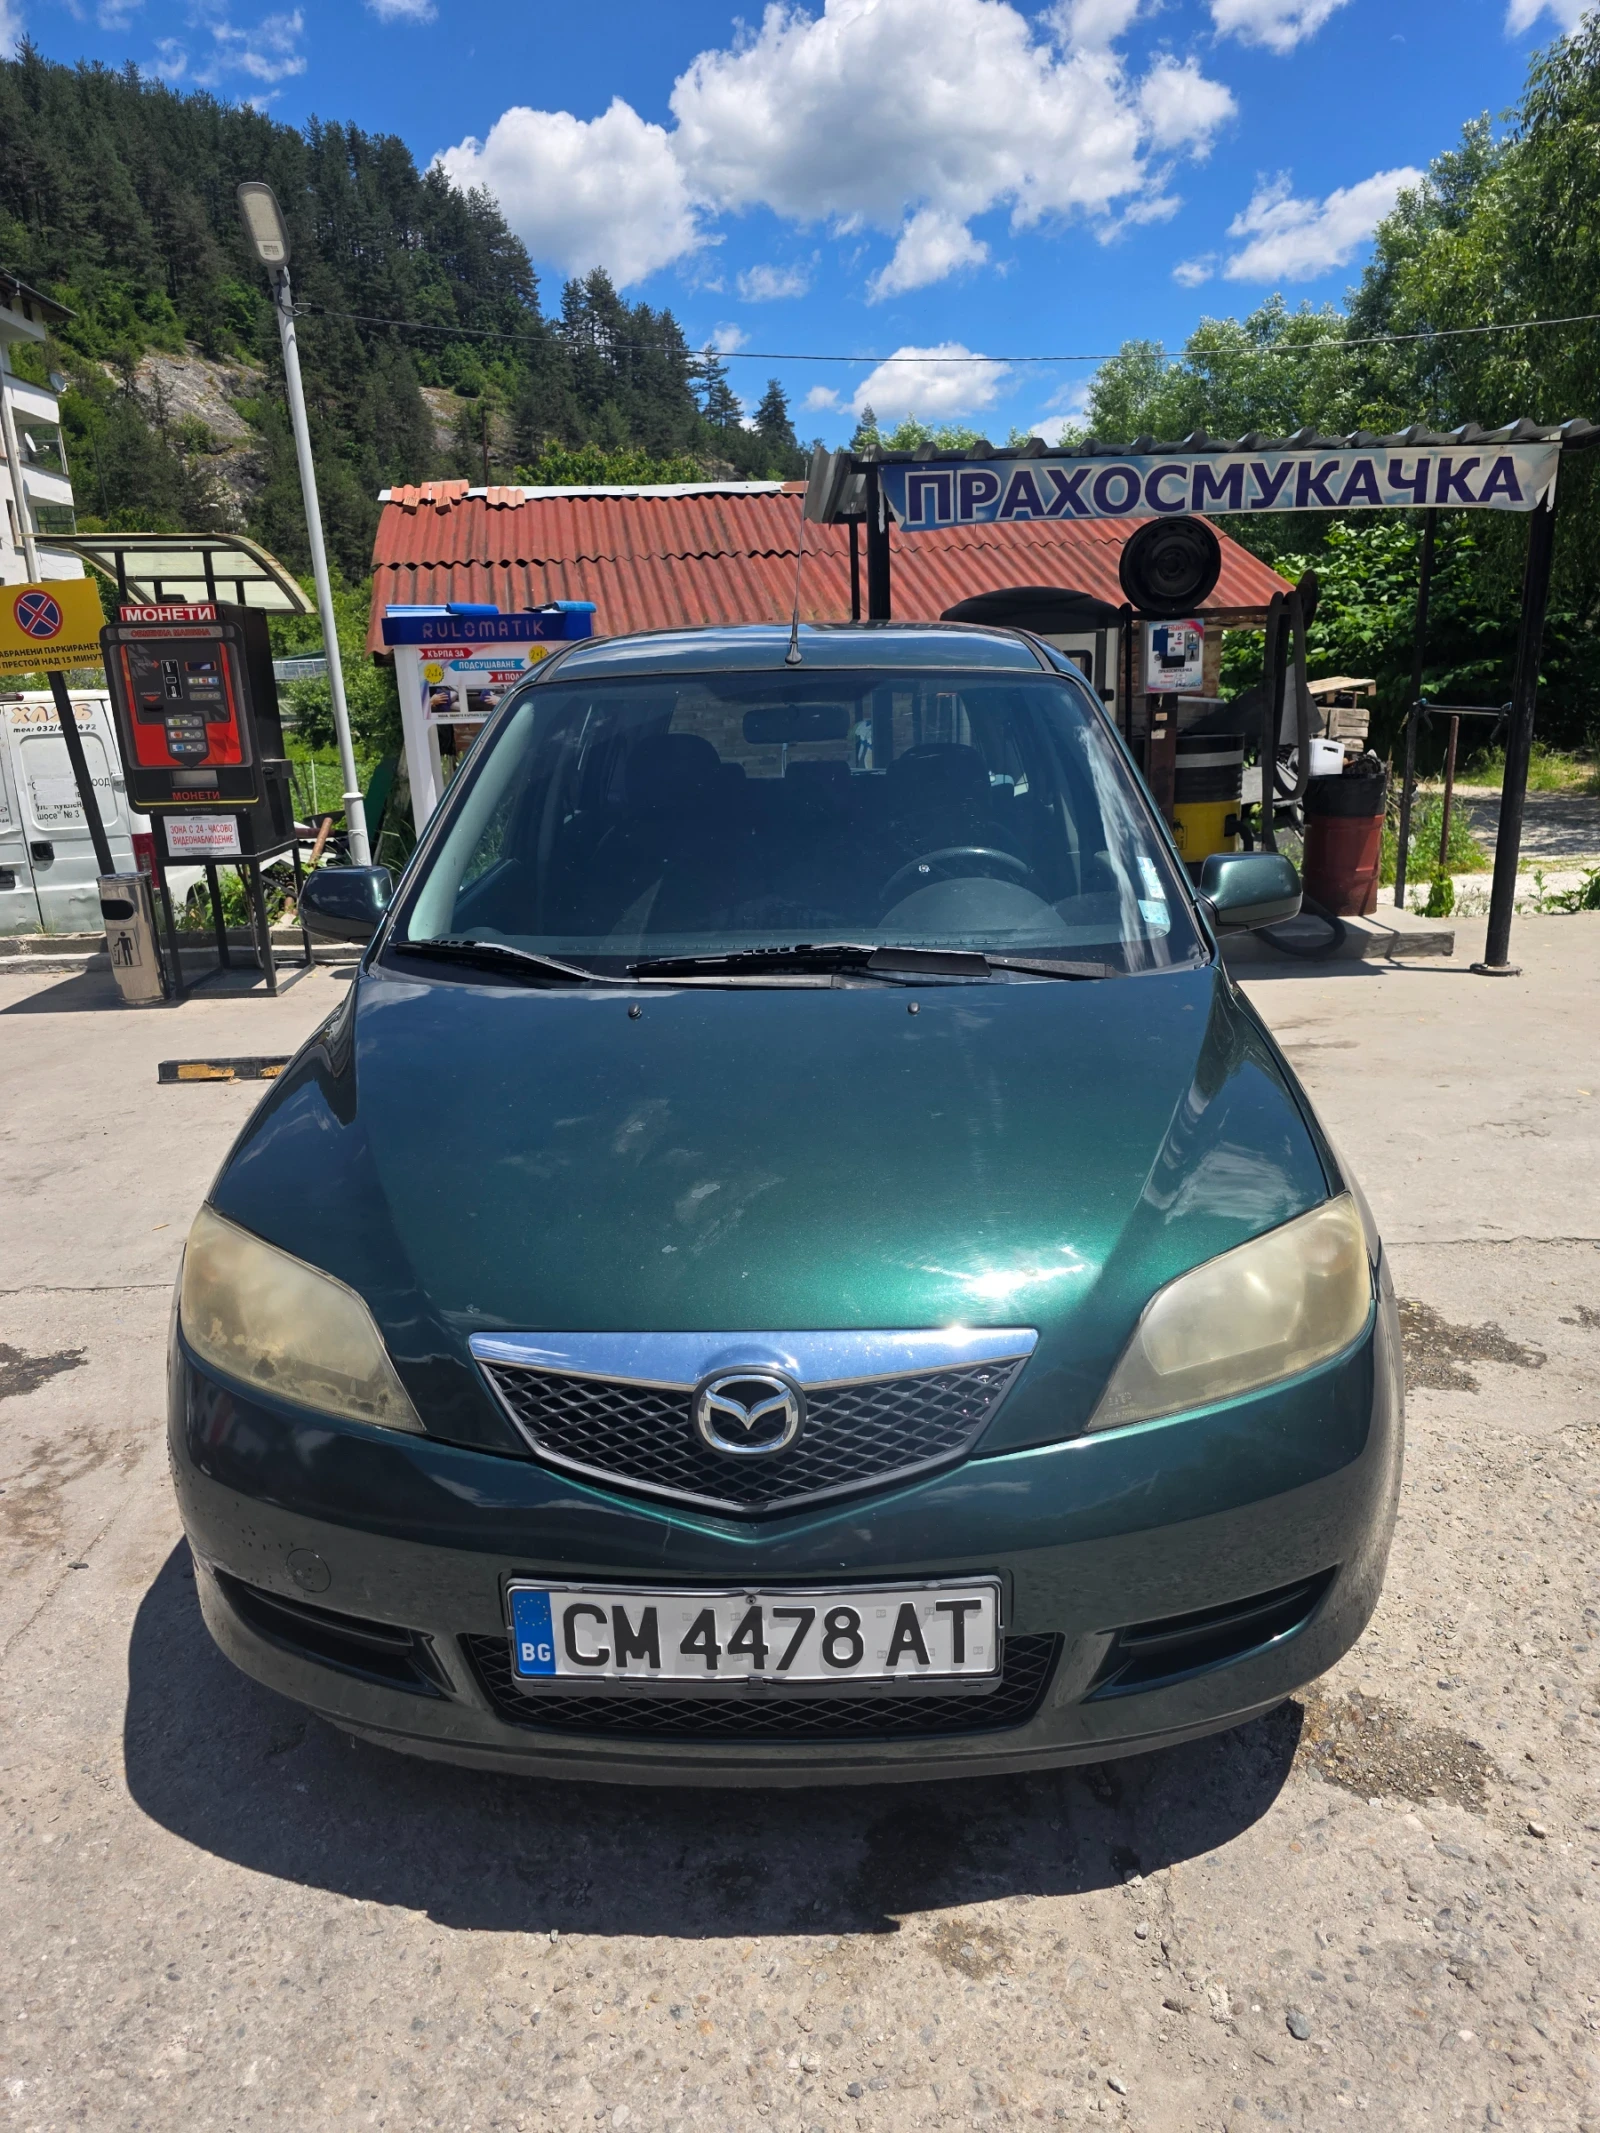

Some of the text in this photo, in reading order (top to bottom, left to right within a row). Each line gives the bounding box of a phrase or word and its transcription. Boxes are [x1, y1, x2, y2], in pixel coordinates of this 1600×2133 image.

[905, 457, 1524, 521] ПРАХОСМУКАЧКА
[126, 607, 212, 621] МОНЕТИ
[422, 620, 544, 638] RULOMATIK
[0, 647, 43, 658] АБРАНЕНИ
[3, 653, 103, 669] ПРЕСТОЙ НАД 15 МИНУТ
[458, 660, 515, 669] ПОДСУШАВАНЕ
[37, 723, 97, 732] 032/6472
[172, 791, 220, 801] МОНЕТИ
[74, 809, 80, 818] 3
[170, 825, 188, 834] ЗОНА
[188, 825, 193, 834] С
[195, 824, 204, 833] 24
[208, 824, 233, 833] ЧАСОВО
[173, 835, 234, 845] ВИДЕОНАБЛЮДЕНИЕ
[563, 1599, 982, 1671] CM 4478 AT
[521, 1643, 550, 1662] BG
